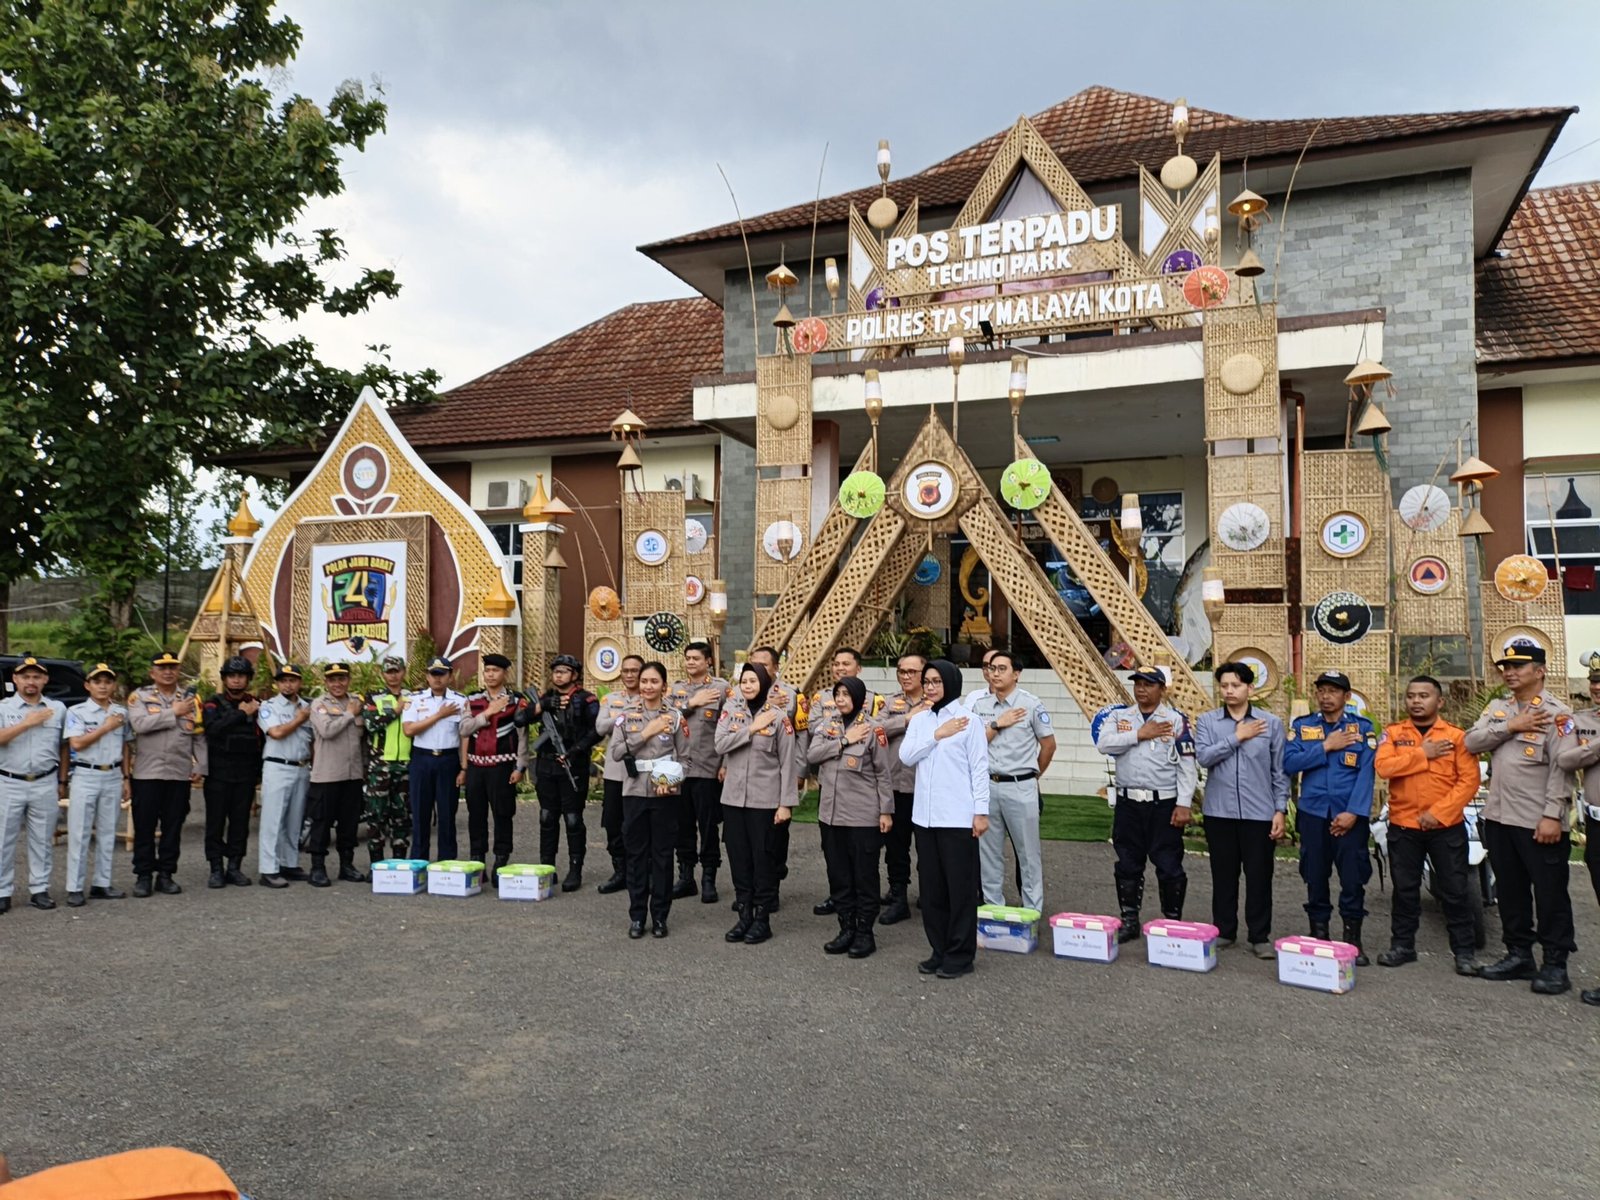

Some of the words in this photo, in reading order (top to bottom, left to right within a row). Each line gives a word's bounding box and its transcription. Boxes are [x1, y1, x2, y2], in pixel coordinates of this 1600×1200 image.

[887, 233, 949, 270] POS
[961, 205, 1116, 258] TERPADU
[927, 257, 1005, 286] TECHNO
[1010, 247, 1072, 274] PARK
[847, 314, 924, 342] POLRES
[1099, 283, 1164, 314] KOTA
[326, 560, 347, 574] POLDA
[350, 557, 369, 568] JAWA
[370, 559, 394, 572] BARAT
[328, 623, 349, 642] JAGA
[351, 622, 387, 641] LEMBUR
